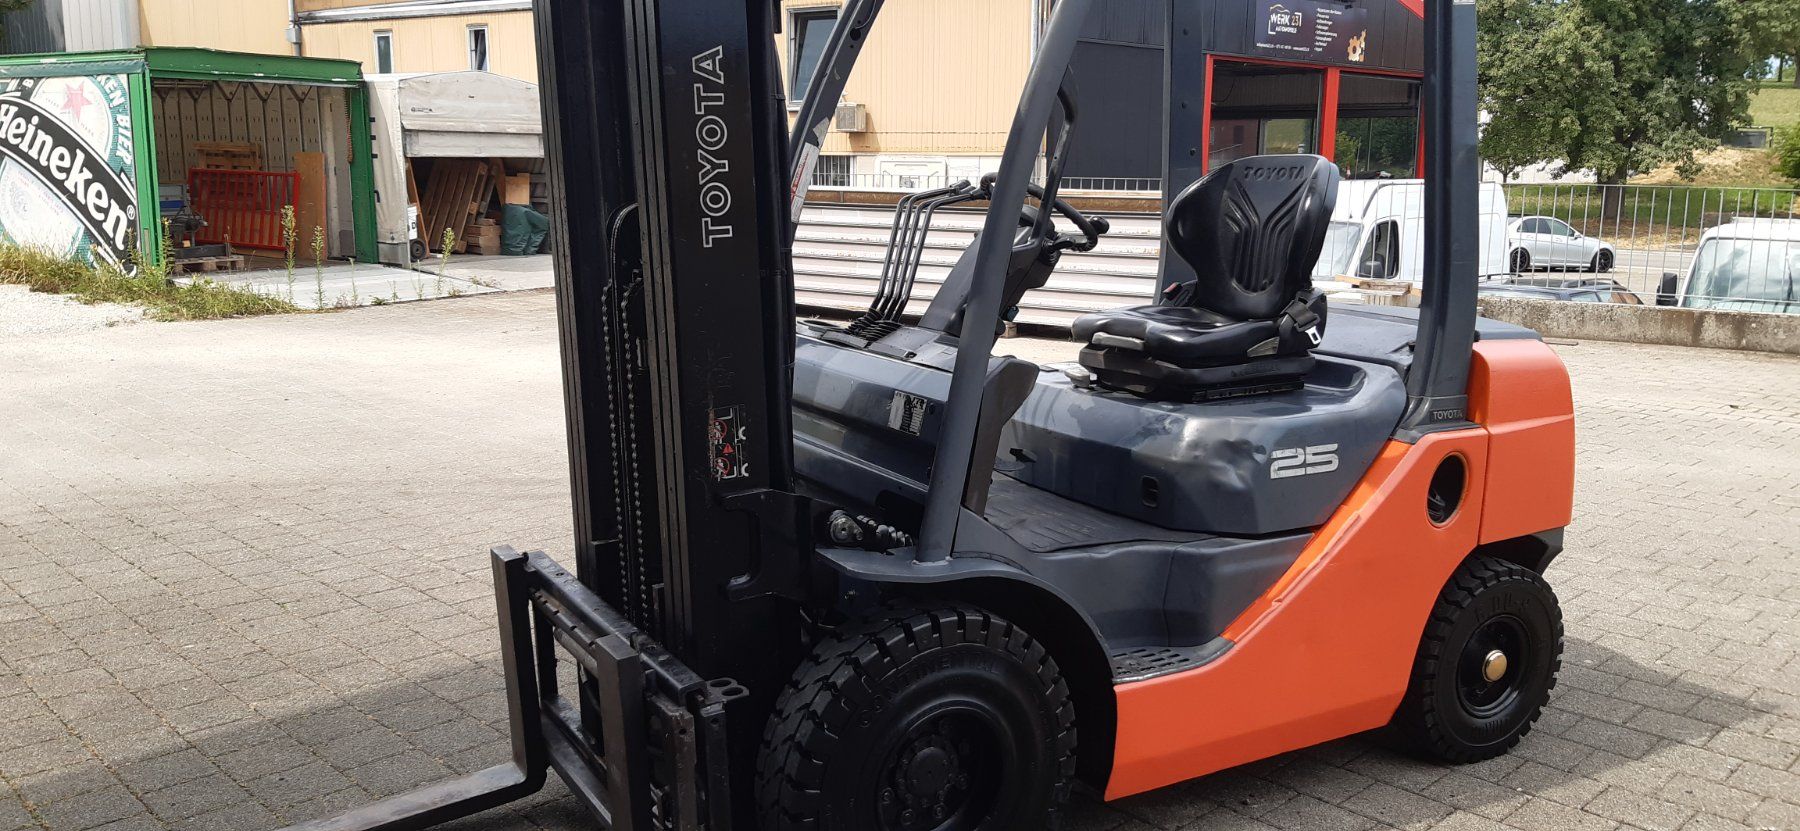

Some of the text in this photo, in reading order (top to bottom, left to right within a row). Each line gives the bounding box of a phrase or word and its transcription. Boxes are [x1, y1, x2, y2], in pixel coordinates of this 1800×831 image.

[1270, 13, 1299, 26] WERK 23
[115, 114, 133, 165] BIER
[692, 45, 733, 248] TOYOTA
[0, 104, 128, 251] Heineken
[1244, 165, 1305, 180] TOYOTA
[1433, 409, 1464, 420] TOYOTA
[1270, 443, 1339, 479] 25
